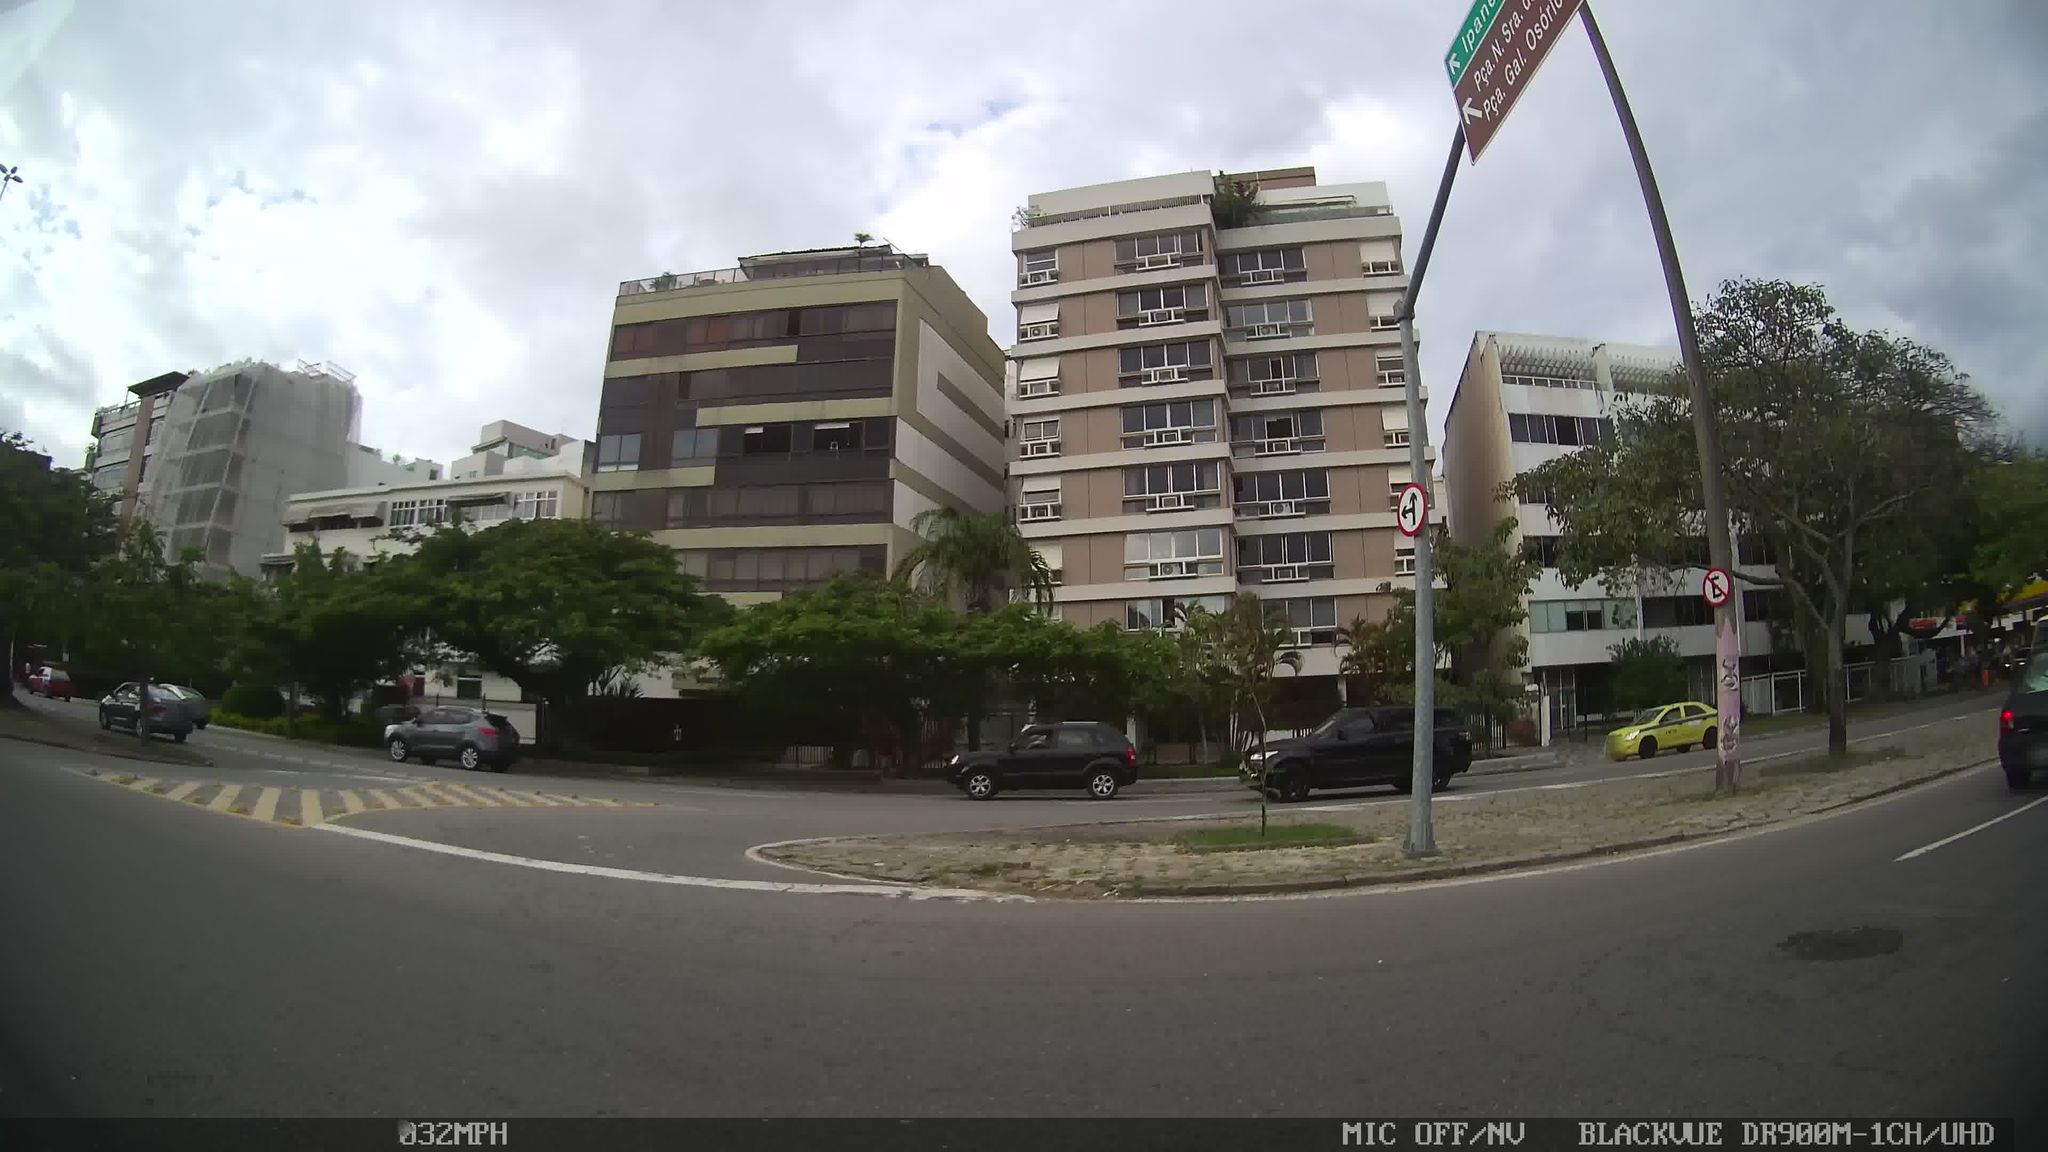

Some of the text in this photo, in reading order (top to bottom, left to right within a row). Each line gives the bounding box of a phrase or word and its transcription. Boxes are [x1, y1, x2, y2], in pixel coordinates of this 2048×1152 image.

[1473, 58, 1496, 92] Pça.
[1501, 11, 1524, 43] Sra.
[1483, 87, 1506, 121] Pça.
[1504, 48, 1527, 86] Gal.
